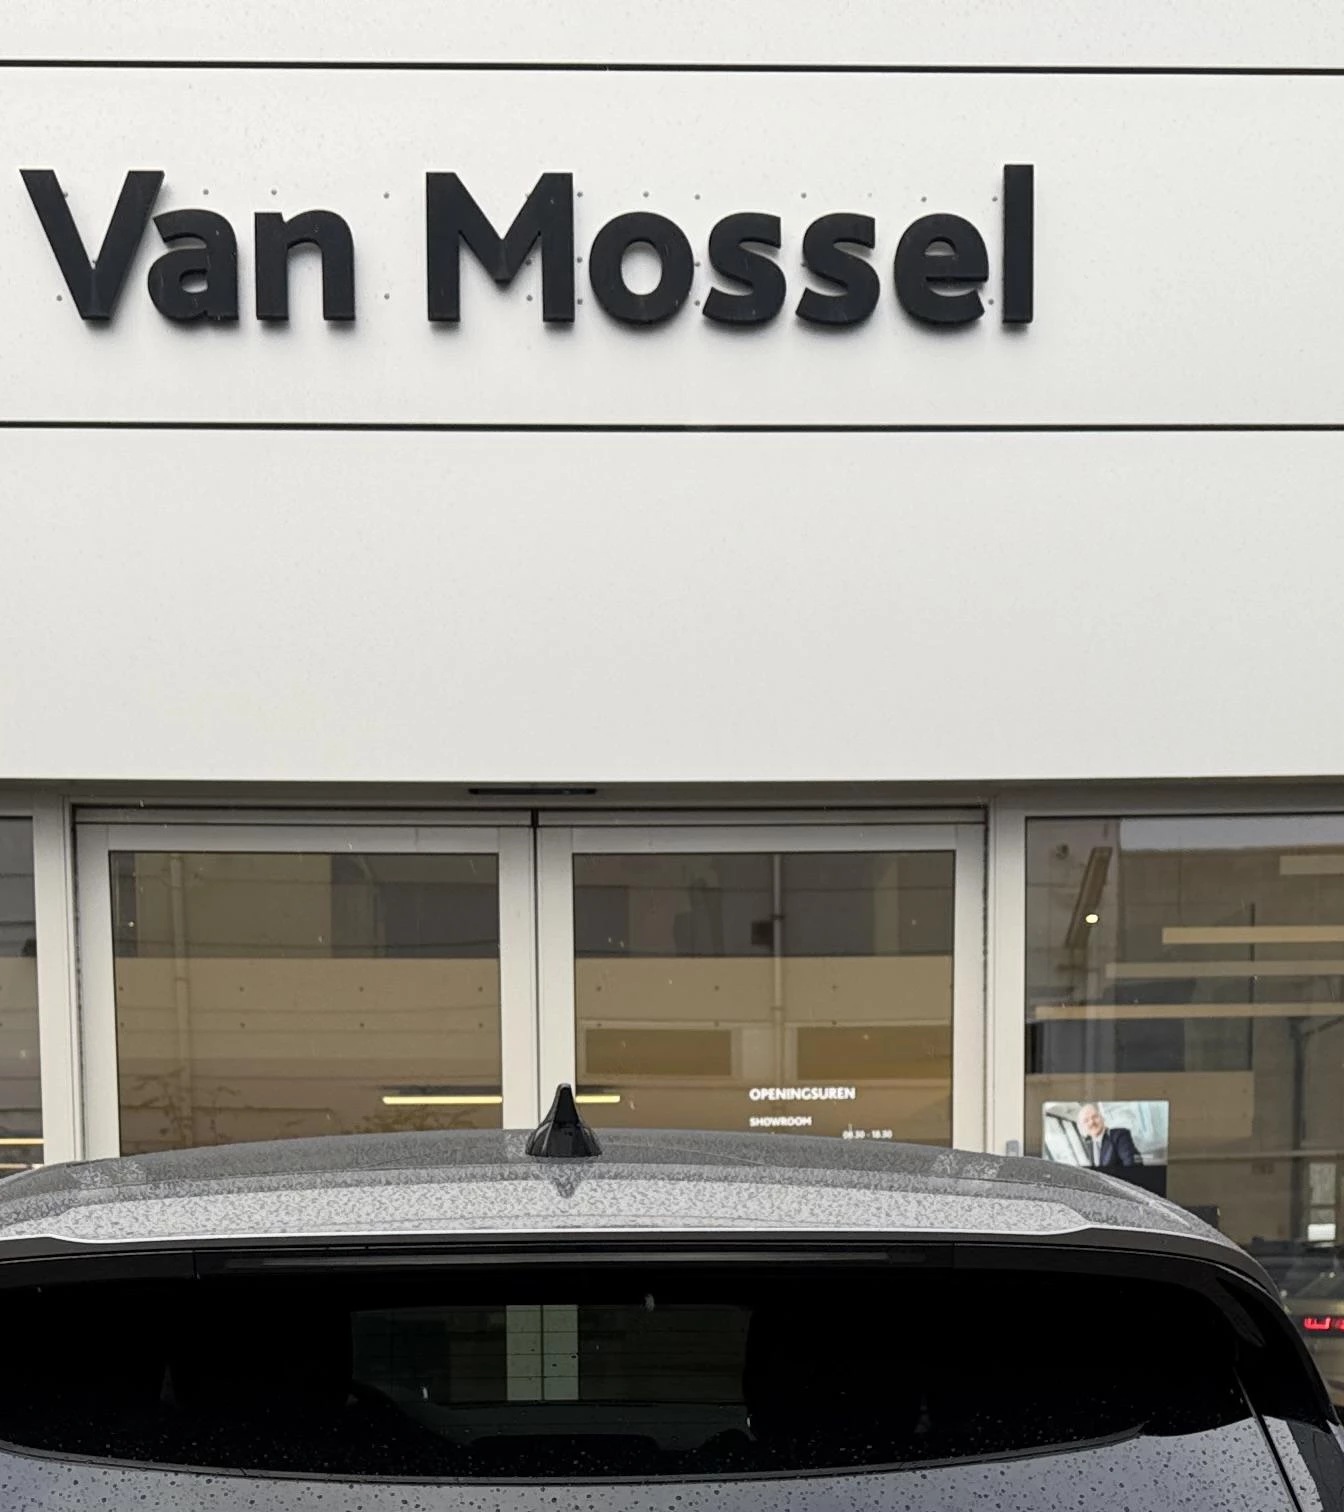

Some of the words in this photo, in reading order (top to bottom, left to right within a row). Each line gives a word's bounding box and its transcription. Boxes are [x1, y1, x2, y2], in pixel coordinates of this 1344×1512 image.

[19, 168, 356, 323] Van
[425, 164, 1034, 325] Mossel
[749, 1087, 856, 1100] OPENINGSUREN
[749, 1116, 812, 1127] SHOWROOM
